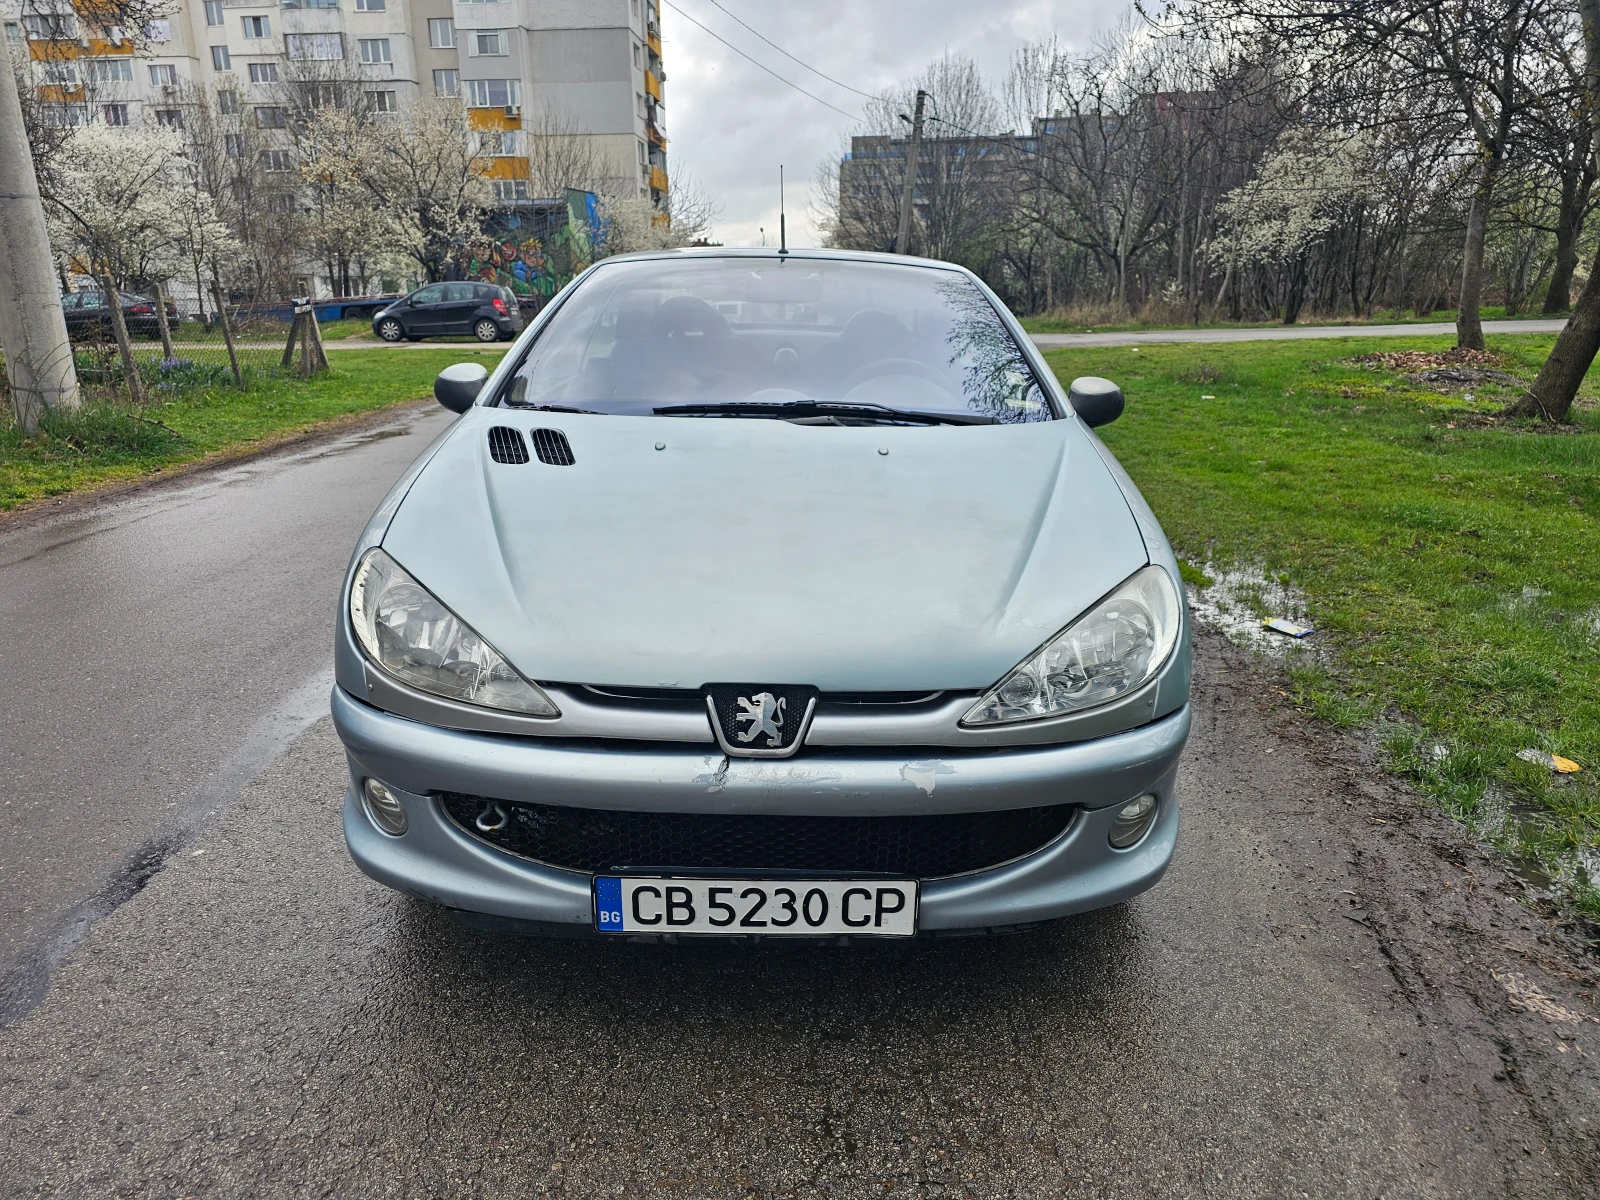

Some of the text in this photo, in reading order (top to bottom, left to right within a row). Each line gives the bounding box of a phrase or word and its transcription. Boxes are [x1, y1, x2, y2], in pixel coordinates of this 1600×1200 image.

[600, 911, 621, 923] BG
[632, 885, 906, 927] CB 5230 CP
